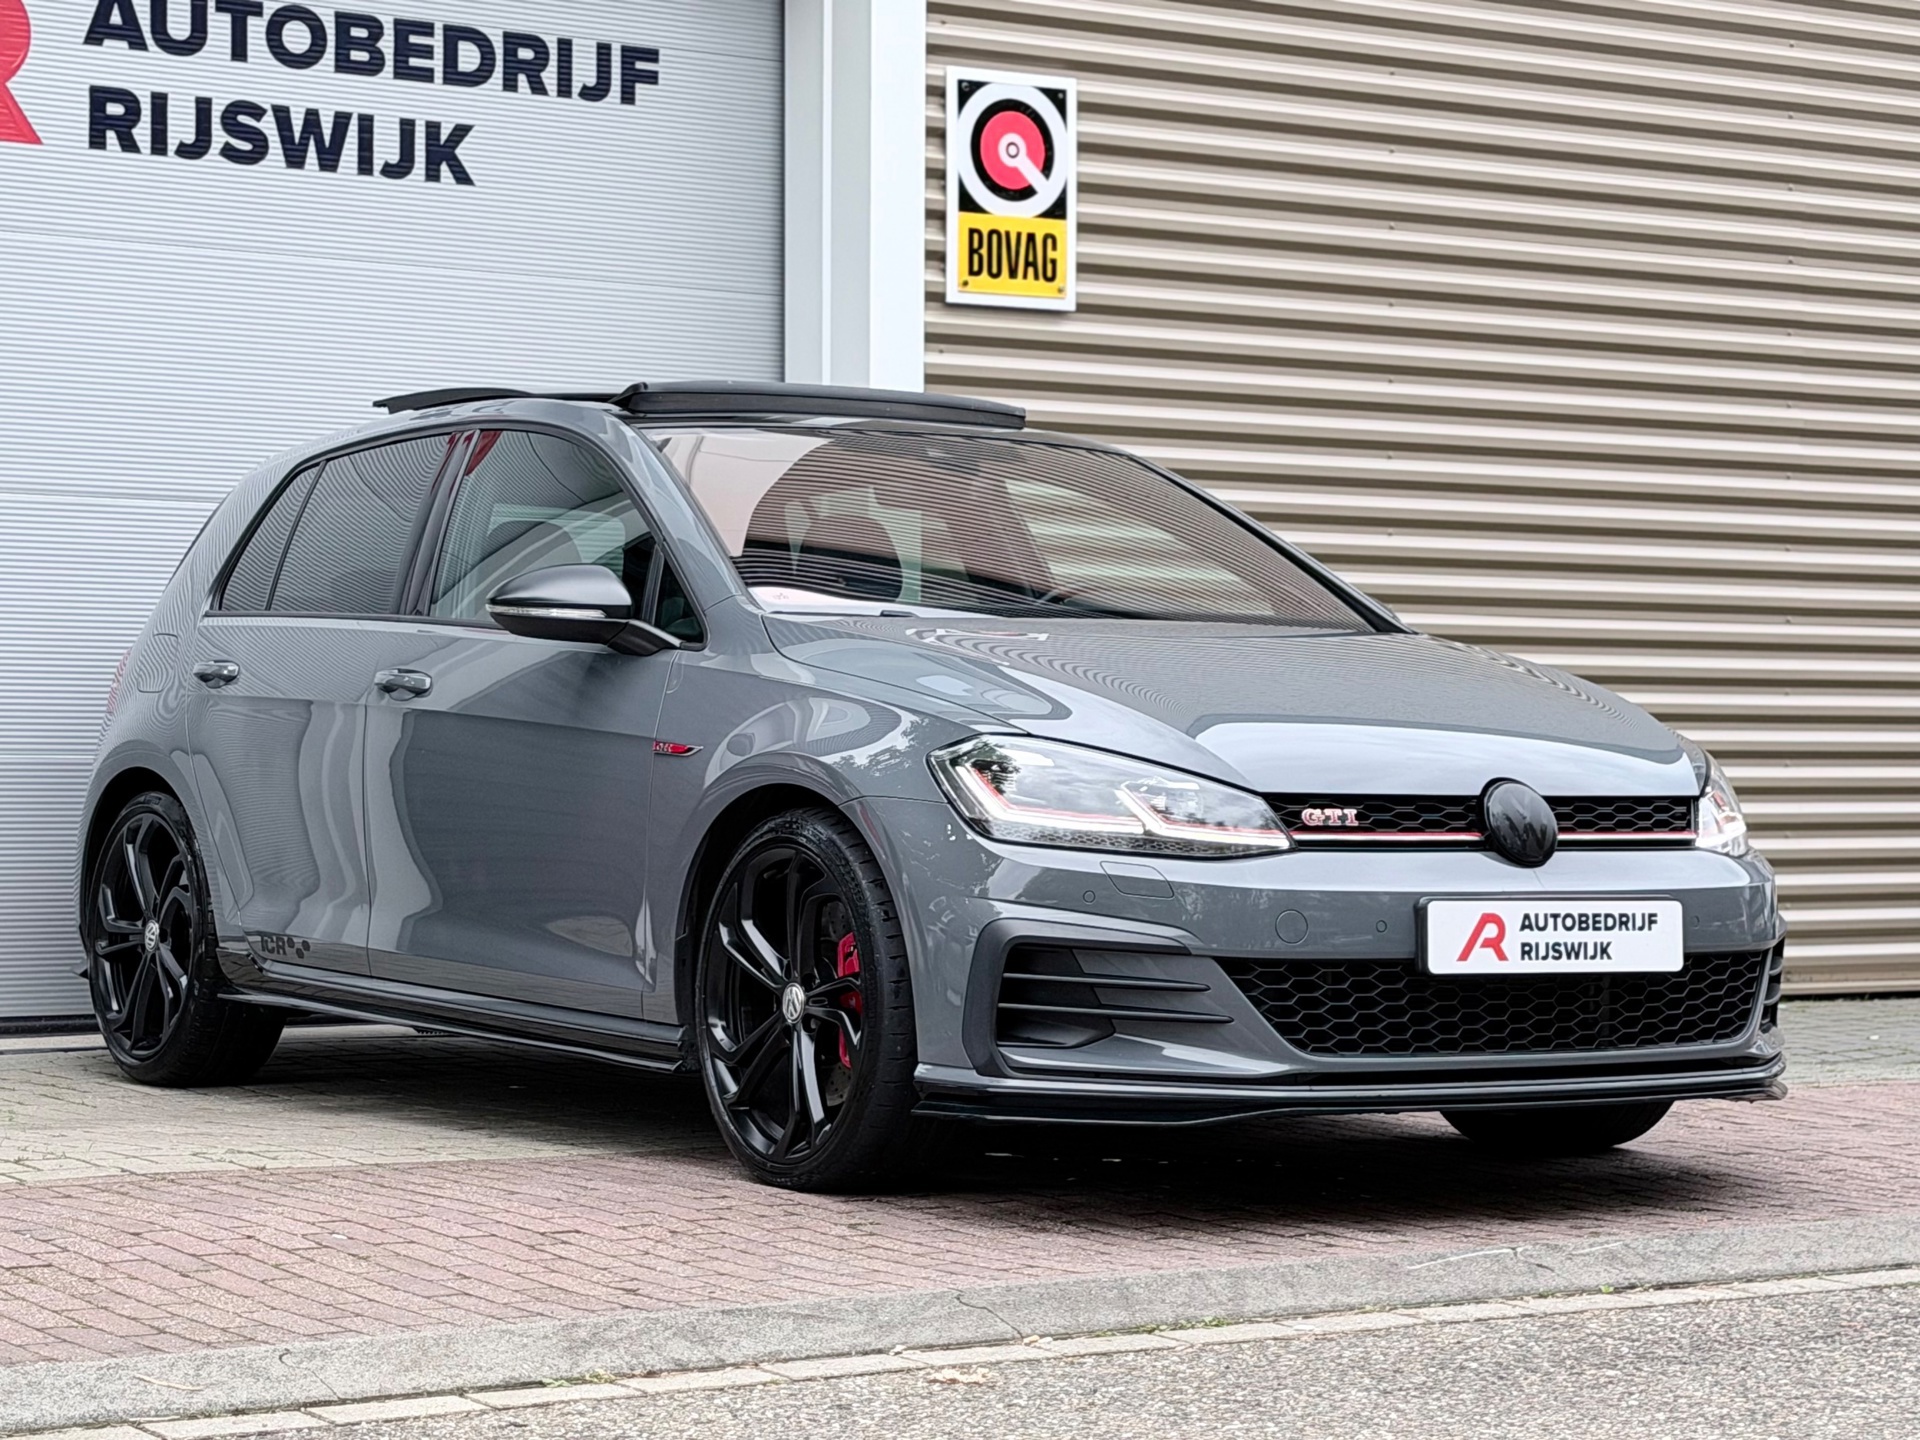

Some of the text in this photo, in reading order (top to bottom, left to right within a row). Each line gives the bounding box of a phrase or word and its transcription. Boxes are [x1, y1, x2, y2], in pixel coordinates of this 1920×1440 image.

[83, 0, 660, 105] AUTOBEDRIJF
[88, 84, 476, 187] RIJSWIJK
[967, 227, 1058, 283] BOVAG
[1301, 808, 1359, 826] GTI
[1519, 912, 1658, 931] AUTOBEDRIJF
[1520, 941, 1613, 961] RIJSWIJK
